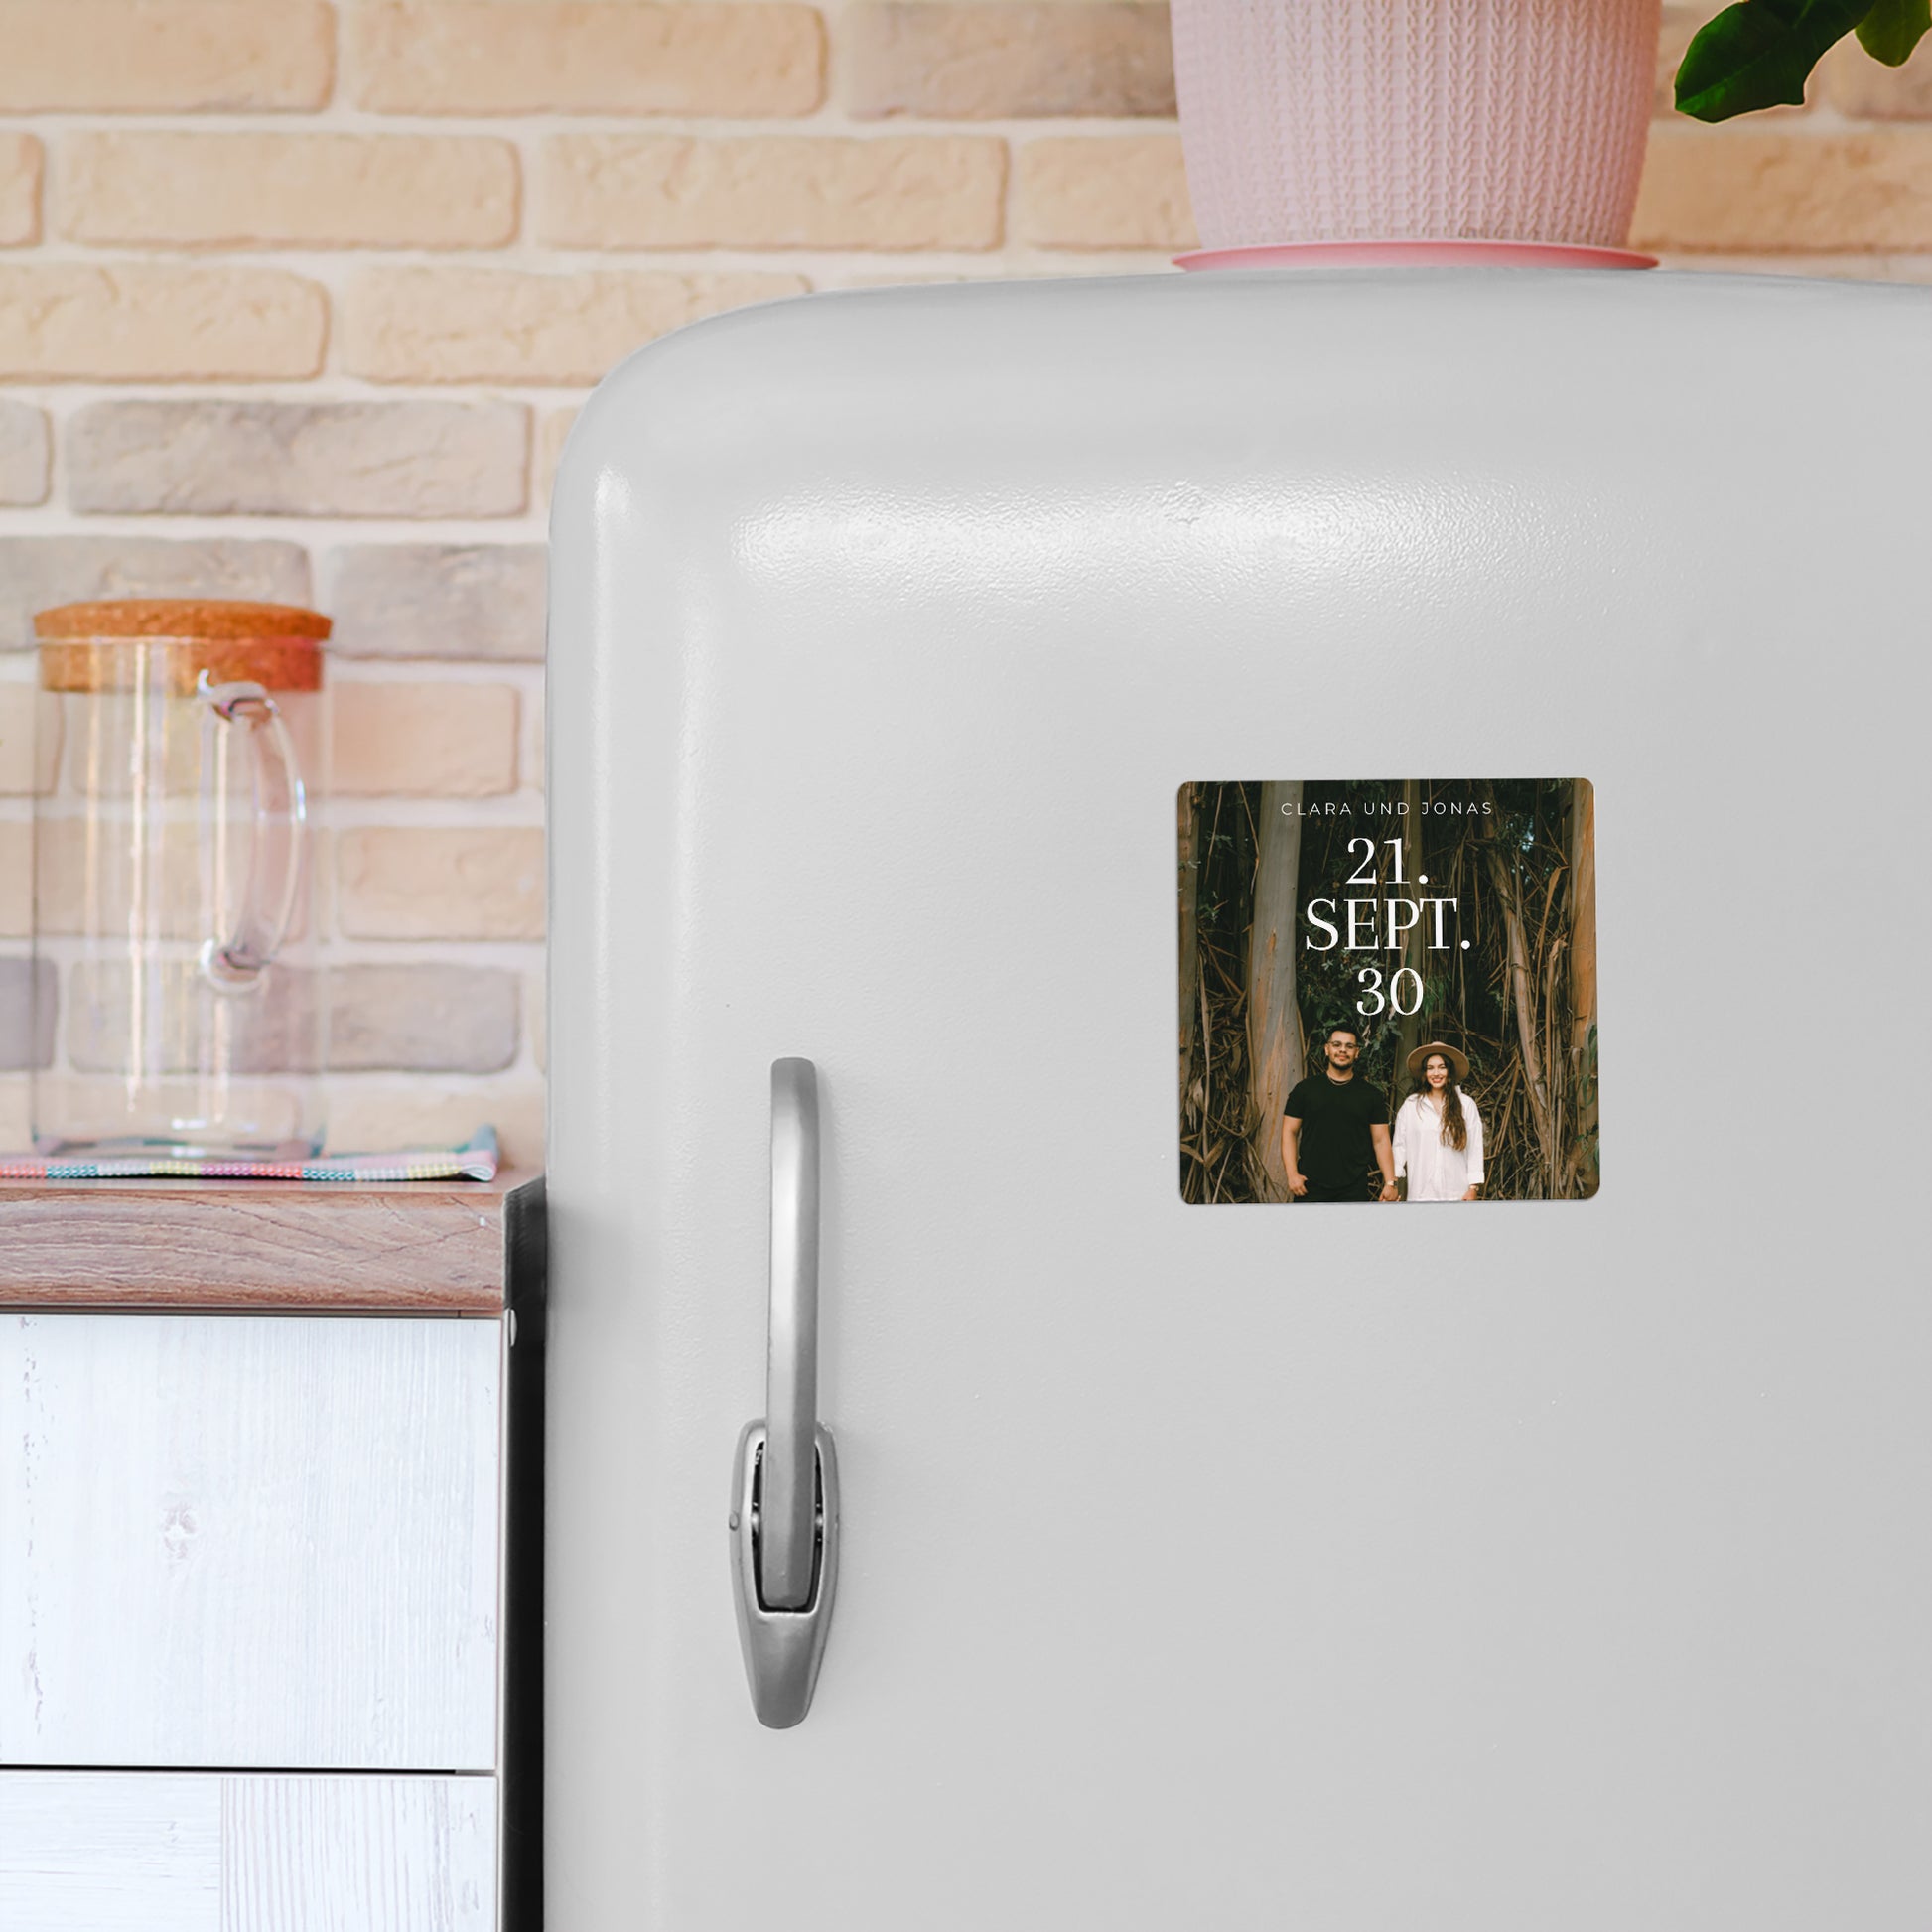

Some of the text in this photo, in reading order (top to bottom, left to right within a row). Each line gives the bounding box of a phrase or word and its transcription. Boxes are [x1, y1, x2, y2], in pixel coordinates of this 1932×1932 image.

[1281, 801, 1493, 816] CLARA UND JONAS
[1345, 837, 1429, 885] 21.
[1306, 897, 1471, 951] SEPT.
[1355, 967, 1425, 1017] 30
